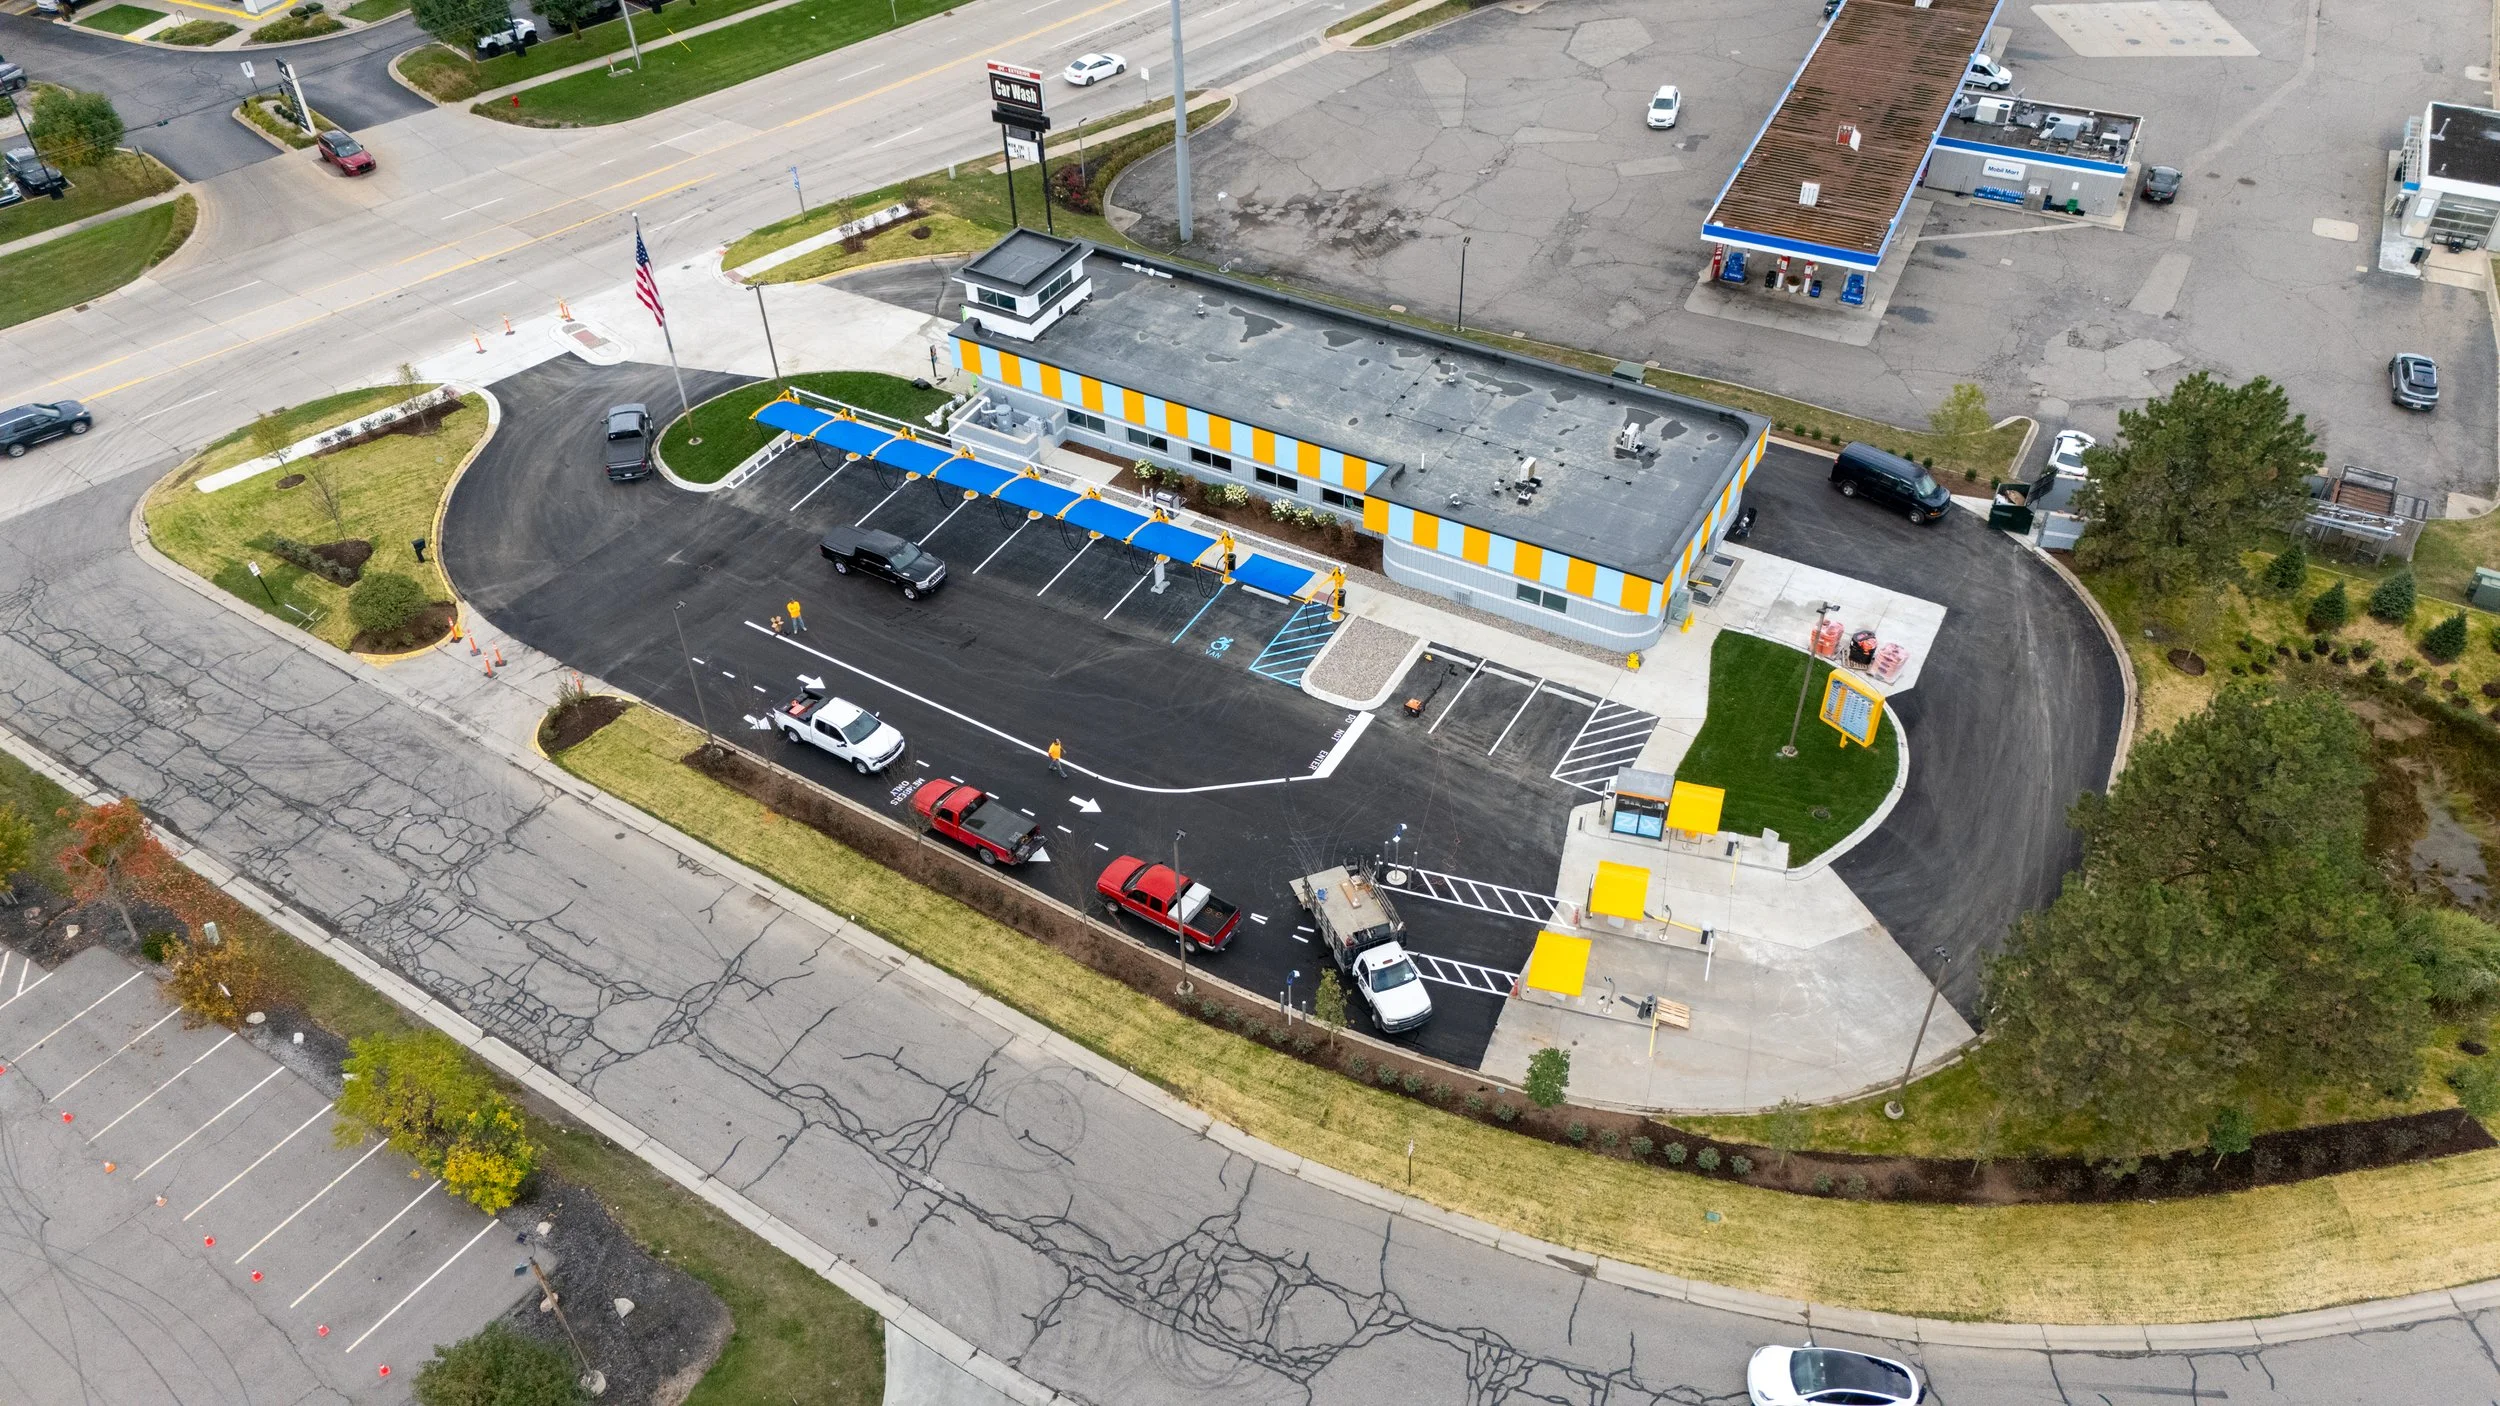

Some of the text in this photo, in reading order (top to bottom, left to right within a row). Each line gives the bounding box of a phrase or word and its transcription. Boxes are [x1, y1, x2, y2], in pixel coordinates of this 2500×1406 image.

[995, 80, 1037, 104] Car Wash
[2005, 168, 2019, 176] Mart
[1205, 648, 1222, 659] VAN
[1308, 713, 1356, 771] DO NOT ENTER
[890, 780, 910, 797] ONLY
[890, 777, 926, 806] MEMBERS
